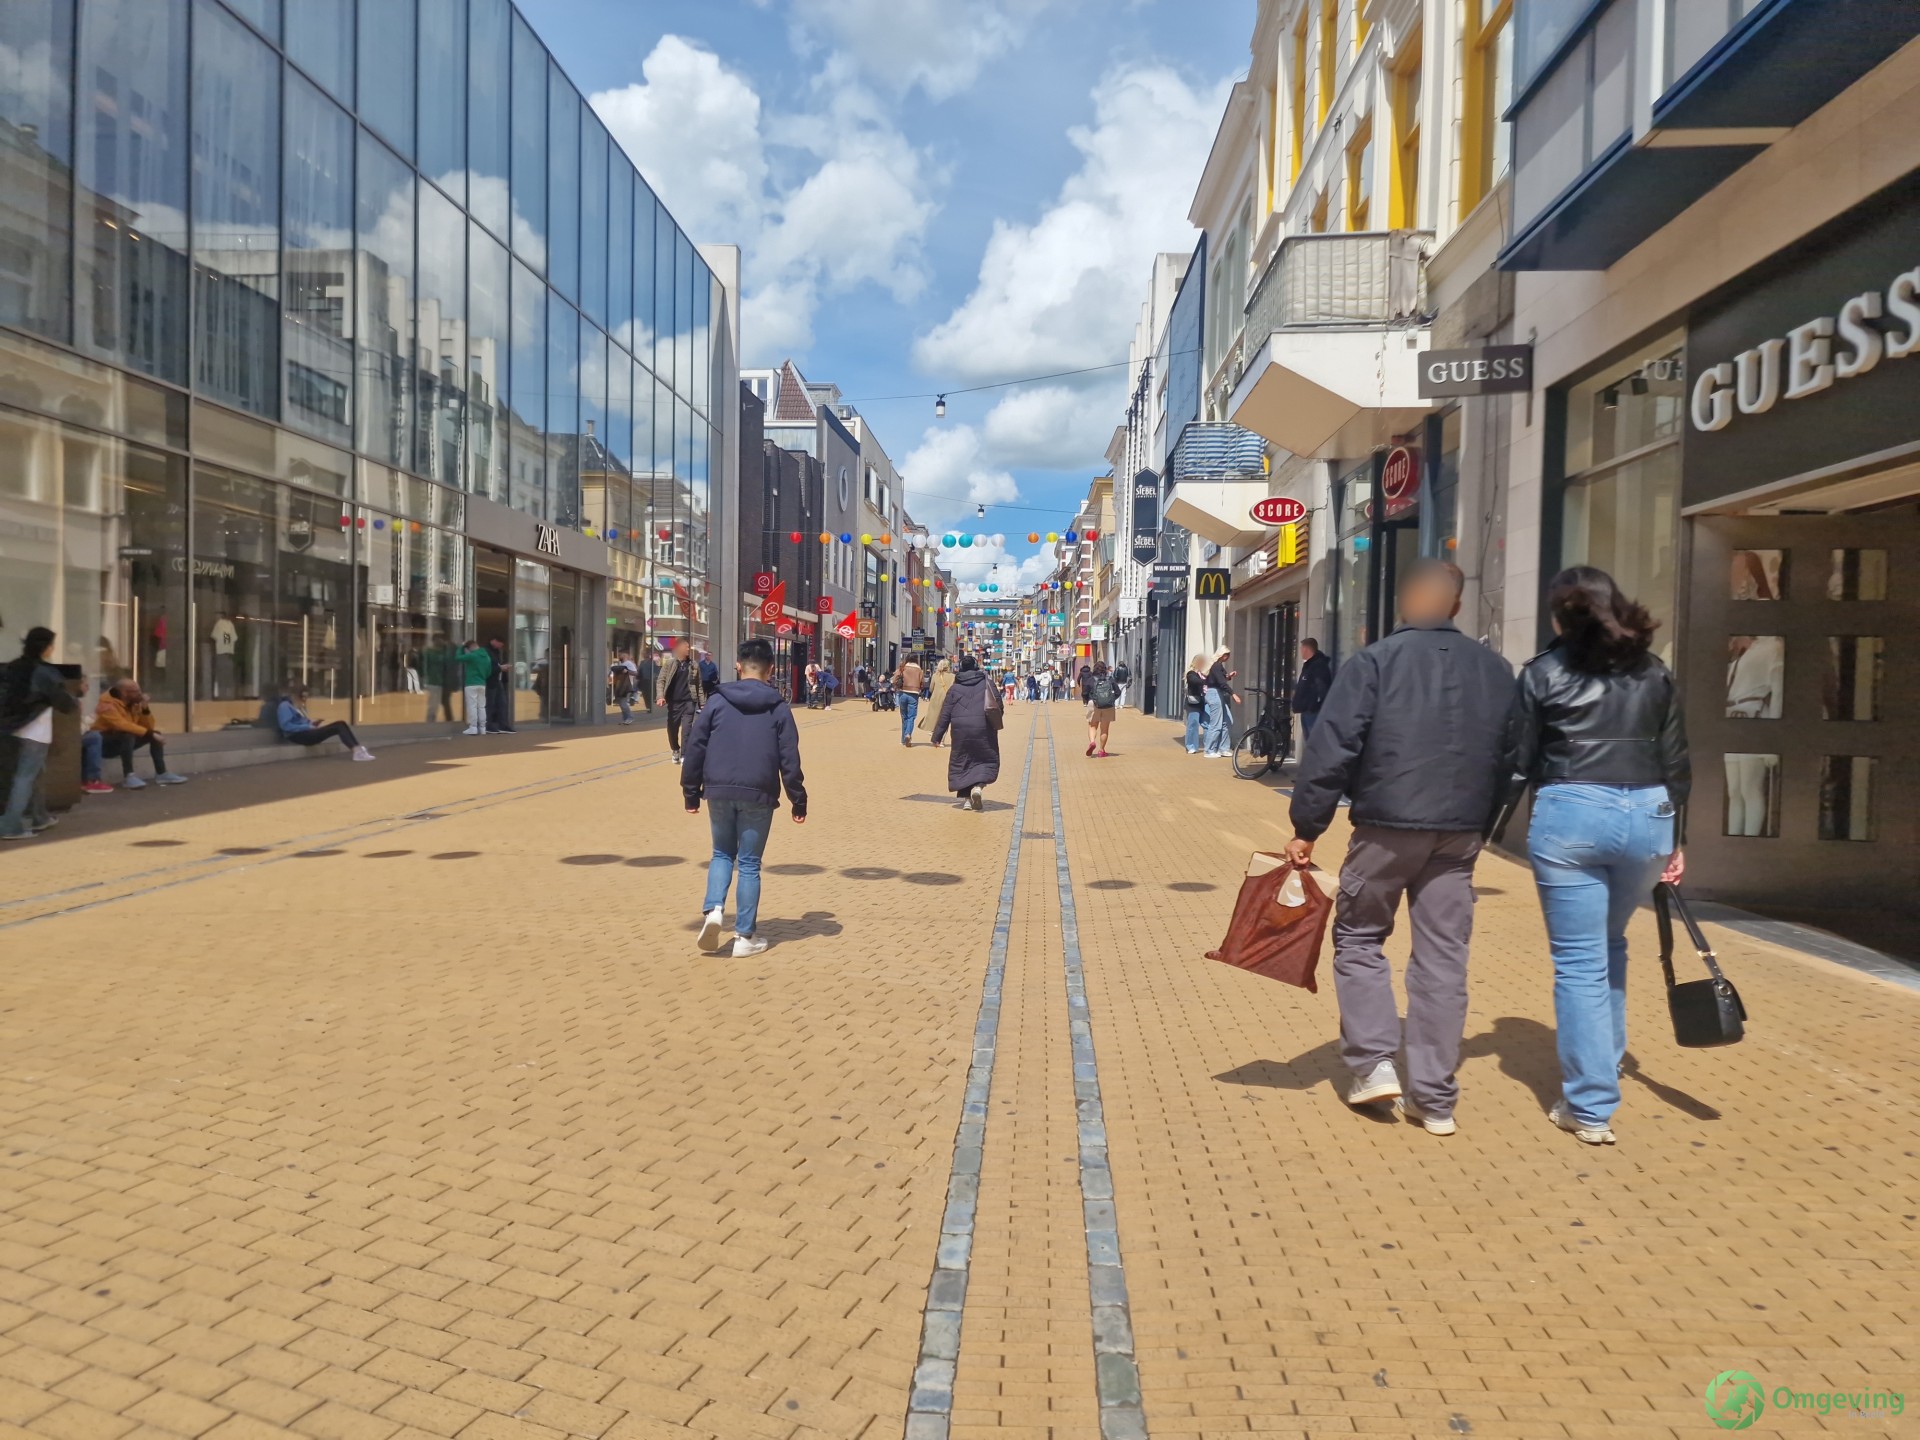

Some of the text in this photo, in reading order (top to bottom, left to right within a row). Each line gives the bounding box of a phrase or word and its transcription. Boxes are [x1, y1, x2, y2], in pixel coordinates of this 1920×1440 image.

[1691, 266, 1920, 433] GUESS
[1427, 356, 1525, 385] GUESS
[1385, 457, 1406, 489] SCORE
[1135, 486, 1157, 496] SIEBEL
[1258, 504, 1300, 518] SCORE
[537, 524, 561, 557] ZARA
[1134, 537, 1155, 546] SIEBEL
